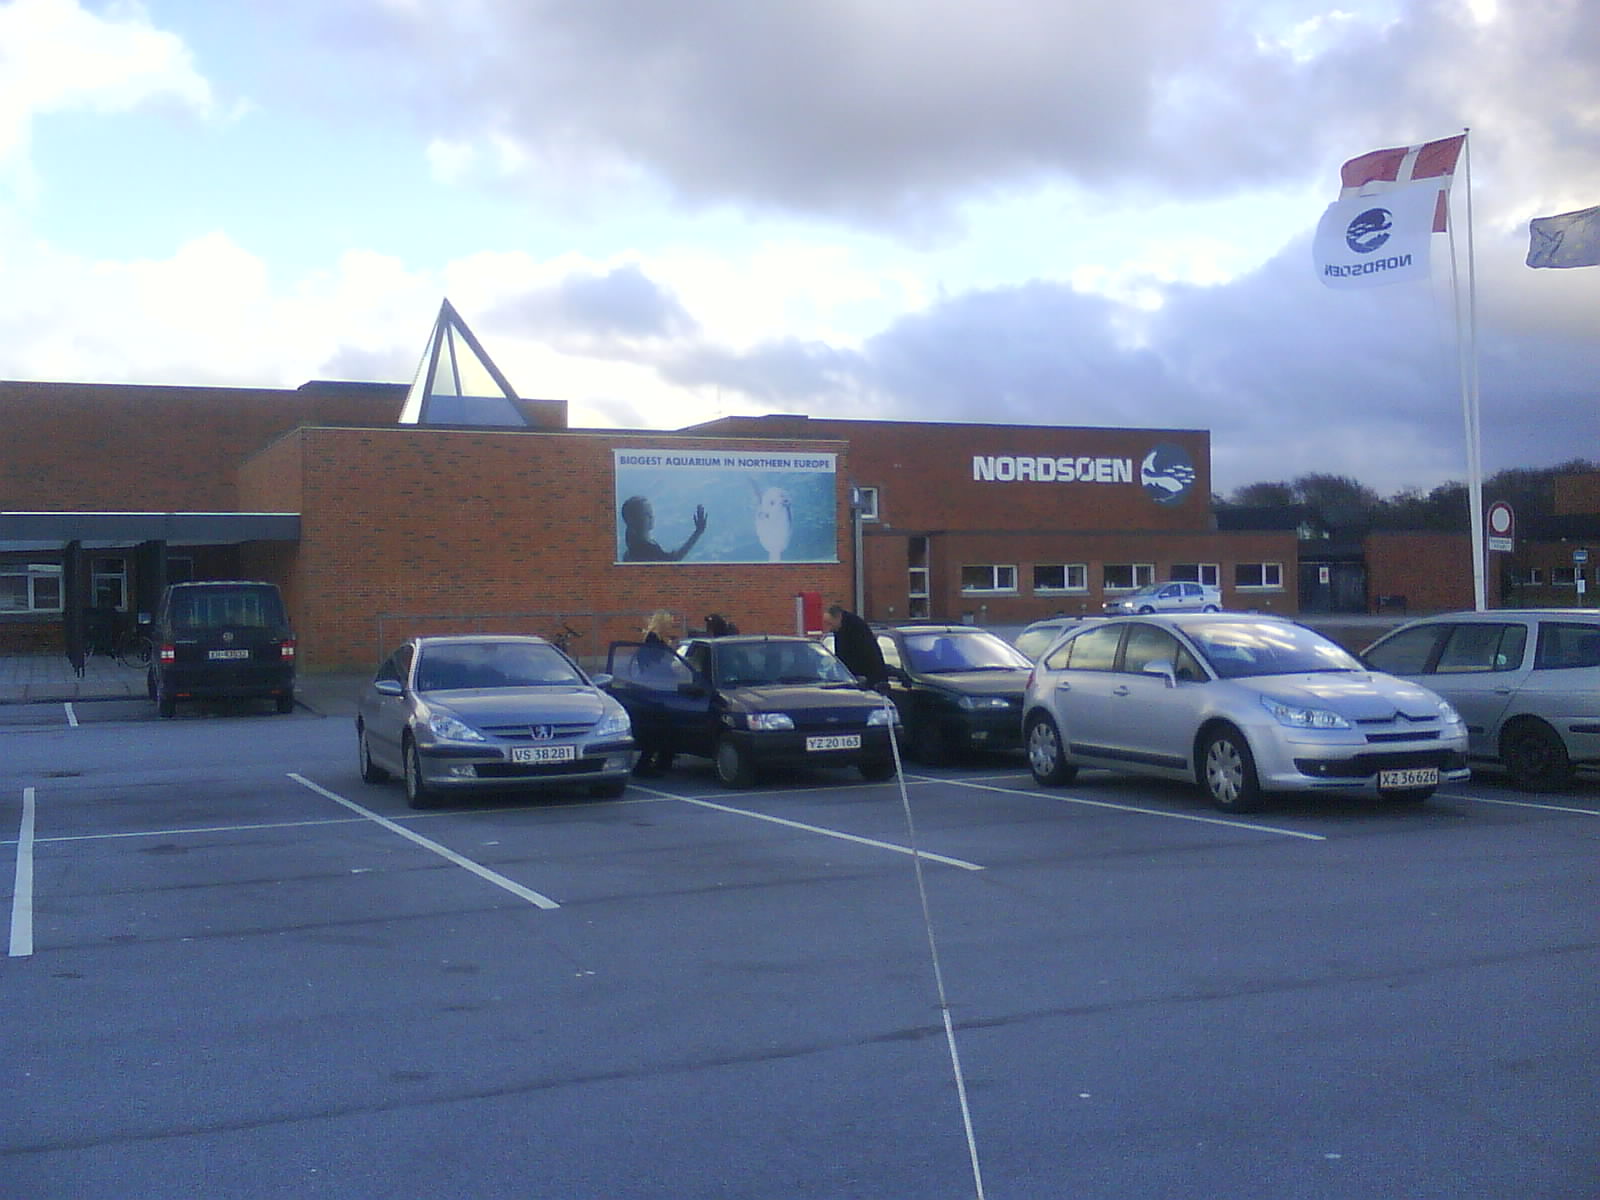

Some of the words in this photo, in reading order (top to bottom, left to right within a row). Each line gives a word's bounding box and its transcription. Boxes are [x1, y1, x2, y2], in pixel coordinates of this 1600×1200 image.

[619, 455, 662, 466] BIGGEST
[666, 457, 721, 467] AQUARIUM
[724, 458, 735, 467] IN
[738, 458, 791, 468] NORTHERN
[794, 459, 830, 469] EUROPE
[973, 456, 1132, 483] NORDSØEN
